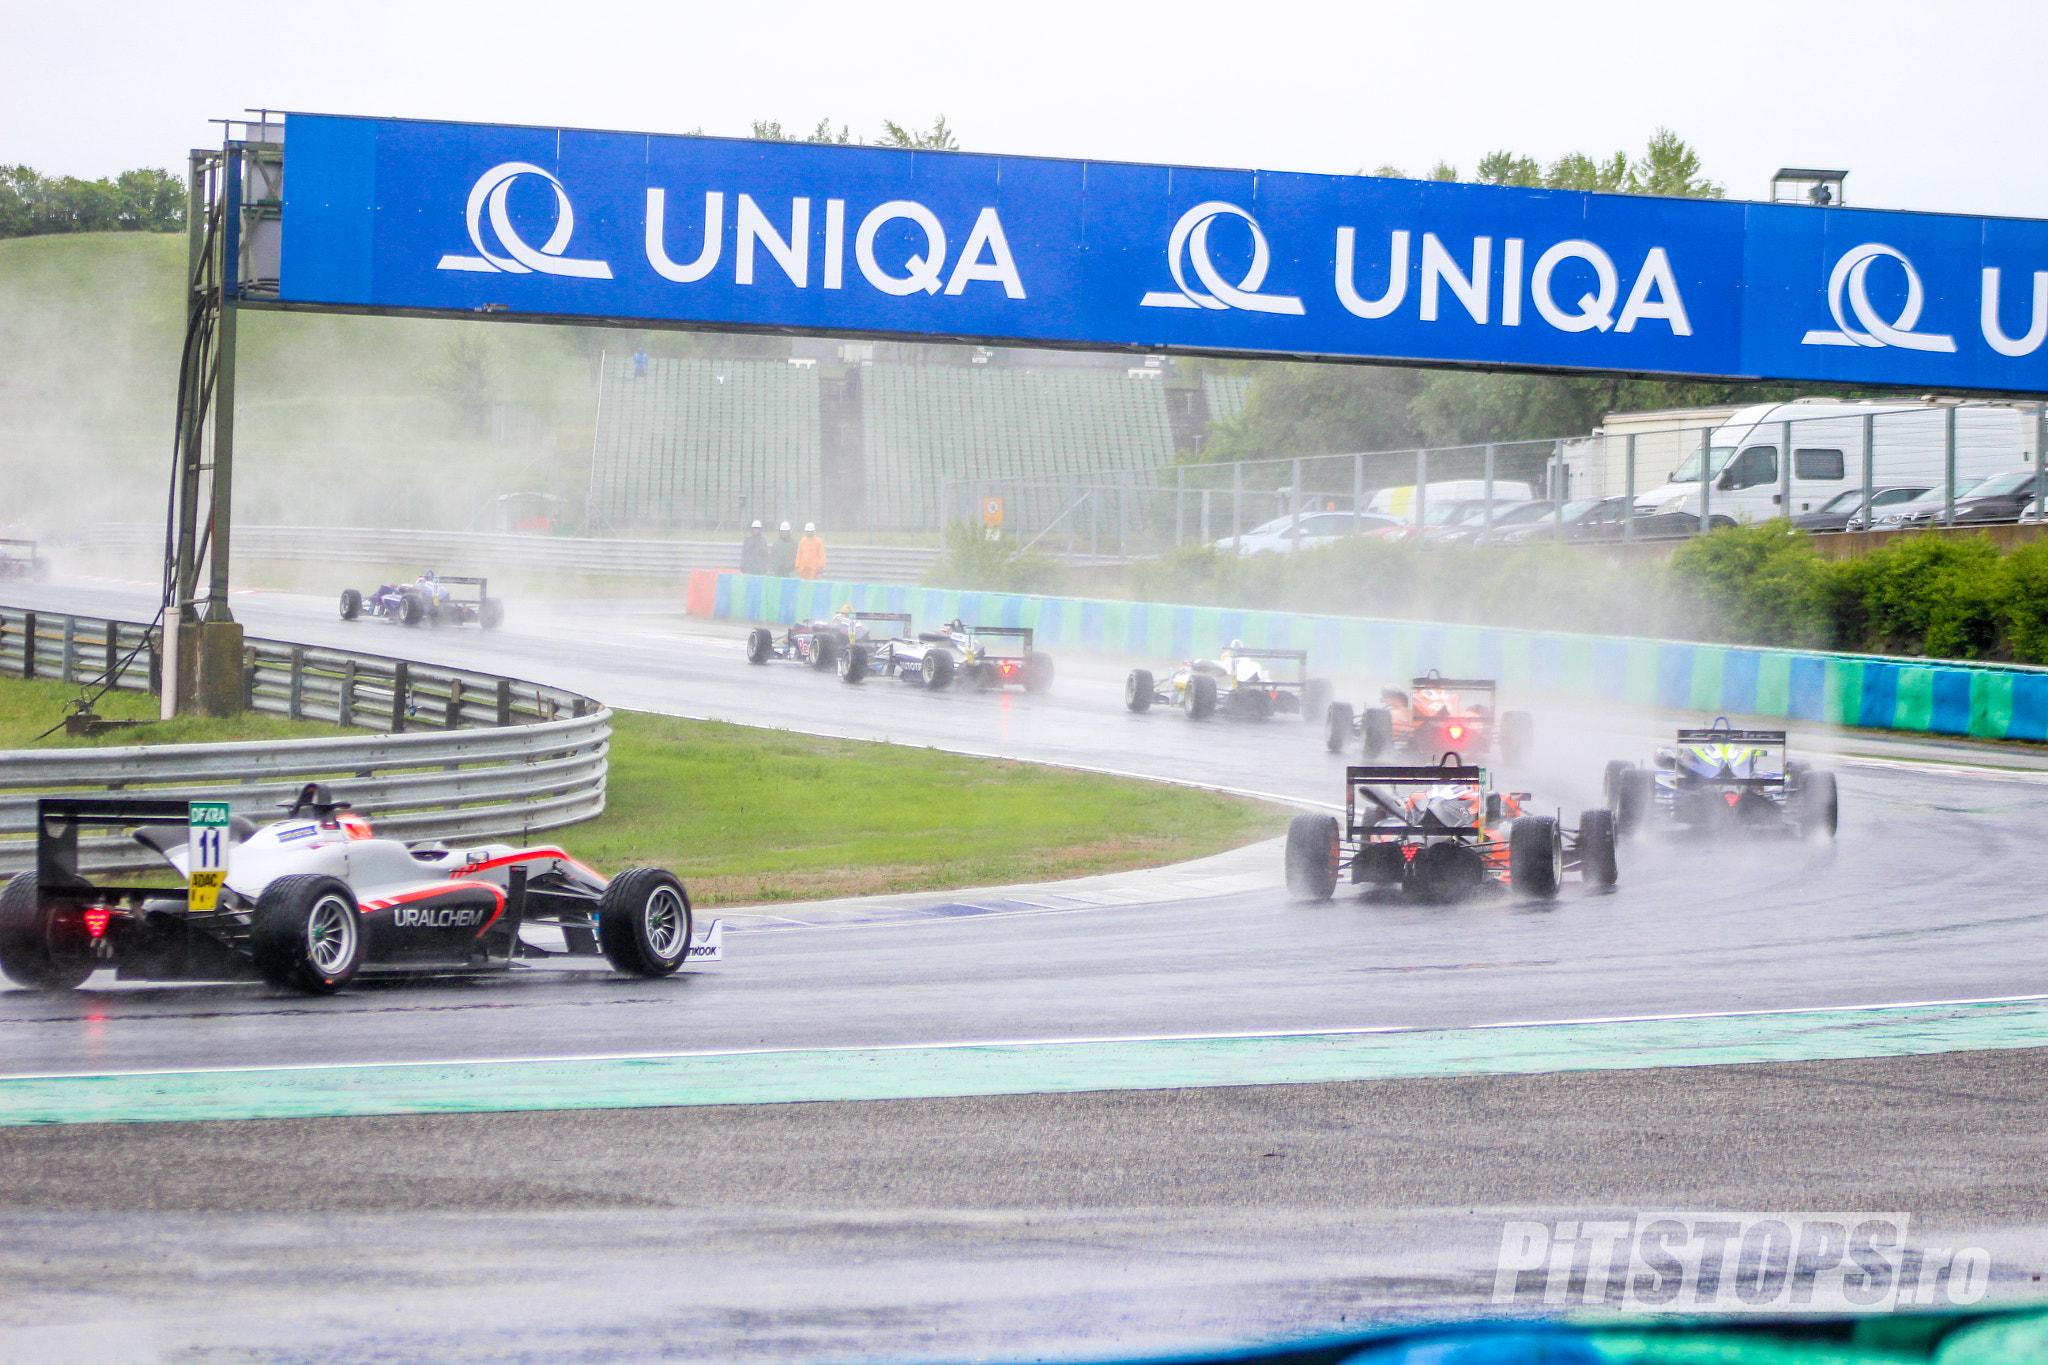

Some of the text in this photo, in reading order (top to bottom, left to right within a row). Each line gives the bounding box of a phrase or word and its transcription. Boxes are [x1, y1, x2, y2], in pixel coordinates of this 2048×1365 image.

[645, 187, 1026, 300] UNIQA
[1335, 225, 1693, 337] UNIQA
[199, 829, 220, 868] 11
[192, 873, 218, 888] ADAC
[394, 909, 484, 927] URALCHEM
